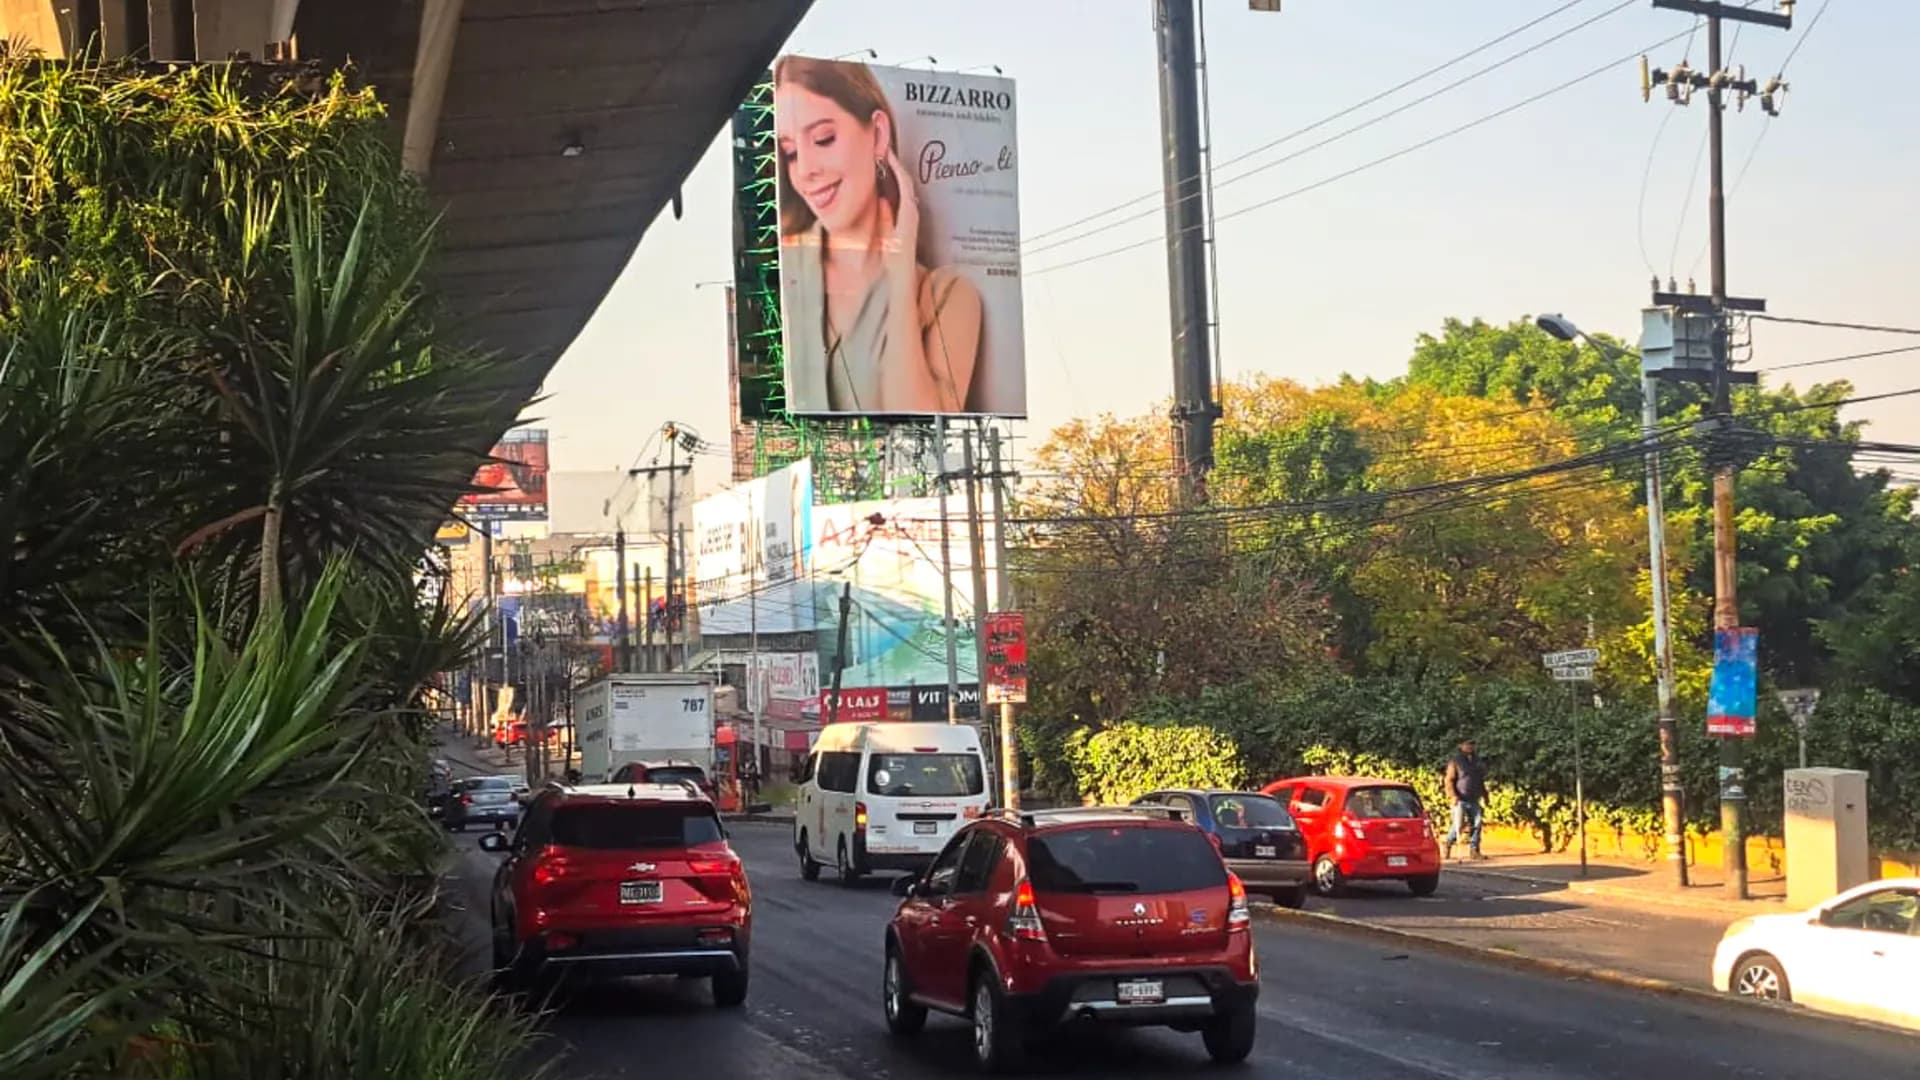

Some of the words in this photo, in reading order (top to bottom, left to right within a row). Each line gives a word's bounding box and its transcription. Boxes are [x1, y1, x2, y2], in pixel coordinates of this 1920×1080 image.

[905, 82, 1011, 111] BIZZARRO
[919, 139, 982, 185] Pienso
[682, 698, 705, 712] 787
